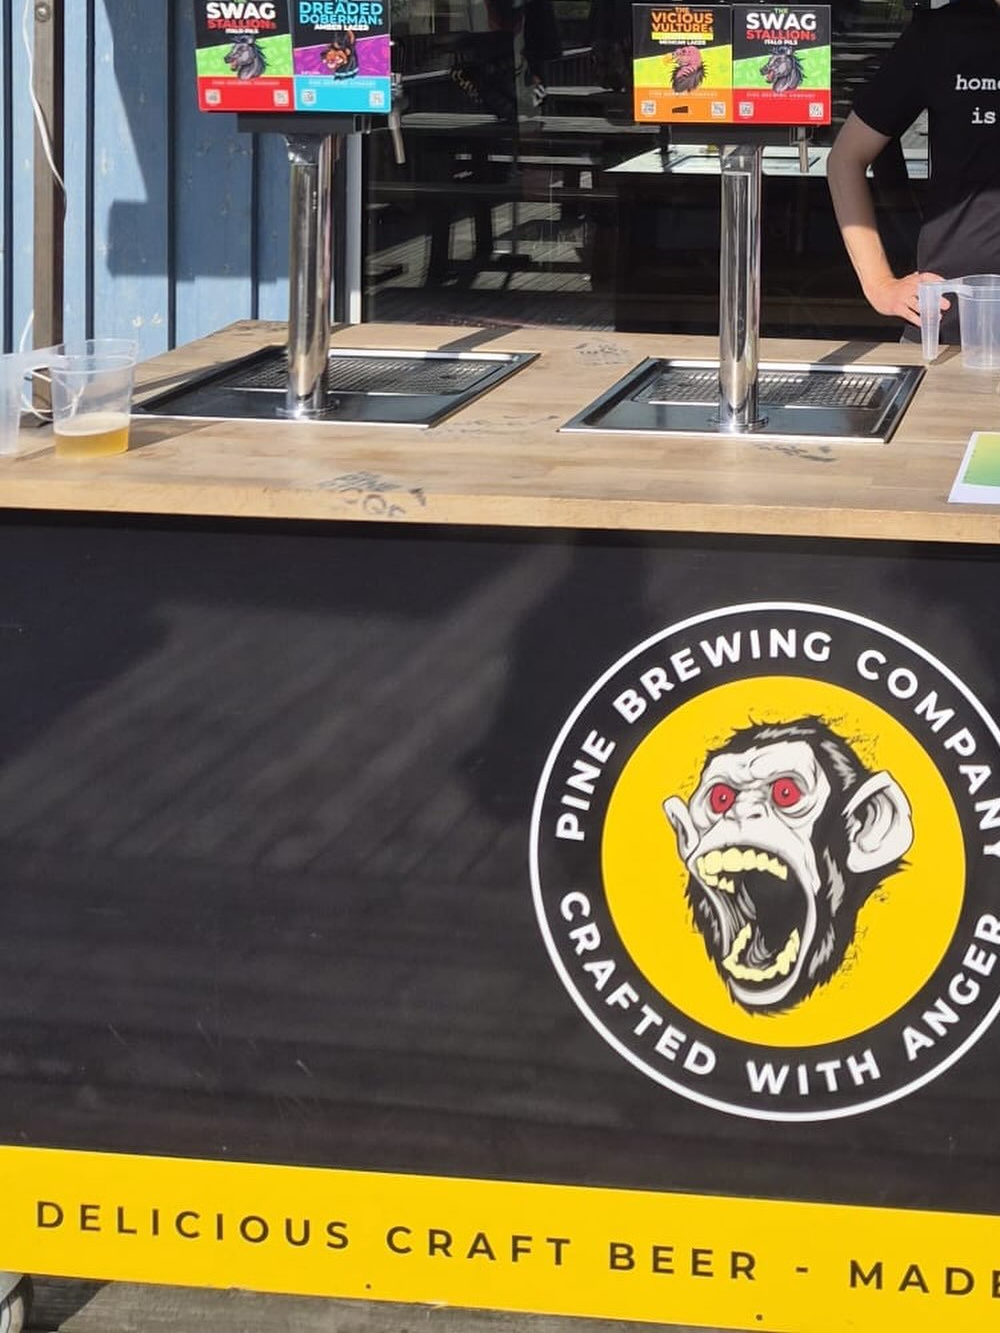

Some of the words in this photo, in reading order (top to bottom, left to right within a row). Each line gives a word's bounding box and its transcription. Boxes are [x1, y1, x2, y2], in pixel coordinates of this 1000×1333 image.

[206, 2, 276, 20] SWAG
[299, 2, 383, 15] DREADED
[651, 12, 714, 25] VICIOUS
[746, 13, 817, 31] SWAG
[971, 108, 996, 125] is
[555, 729, 616, 843] PINE
[612, 627, 832, 726] BREWING
[559, 890, 717, 1077] CRAFTED
[745, 1049, 882, 1097] WITH
[36, 1200, 349, 1250] DELICIOUS
[386, 1226, 572, 1266] CRAFT
[608, 1241, 757, 1282] BEER
